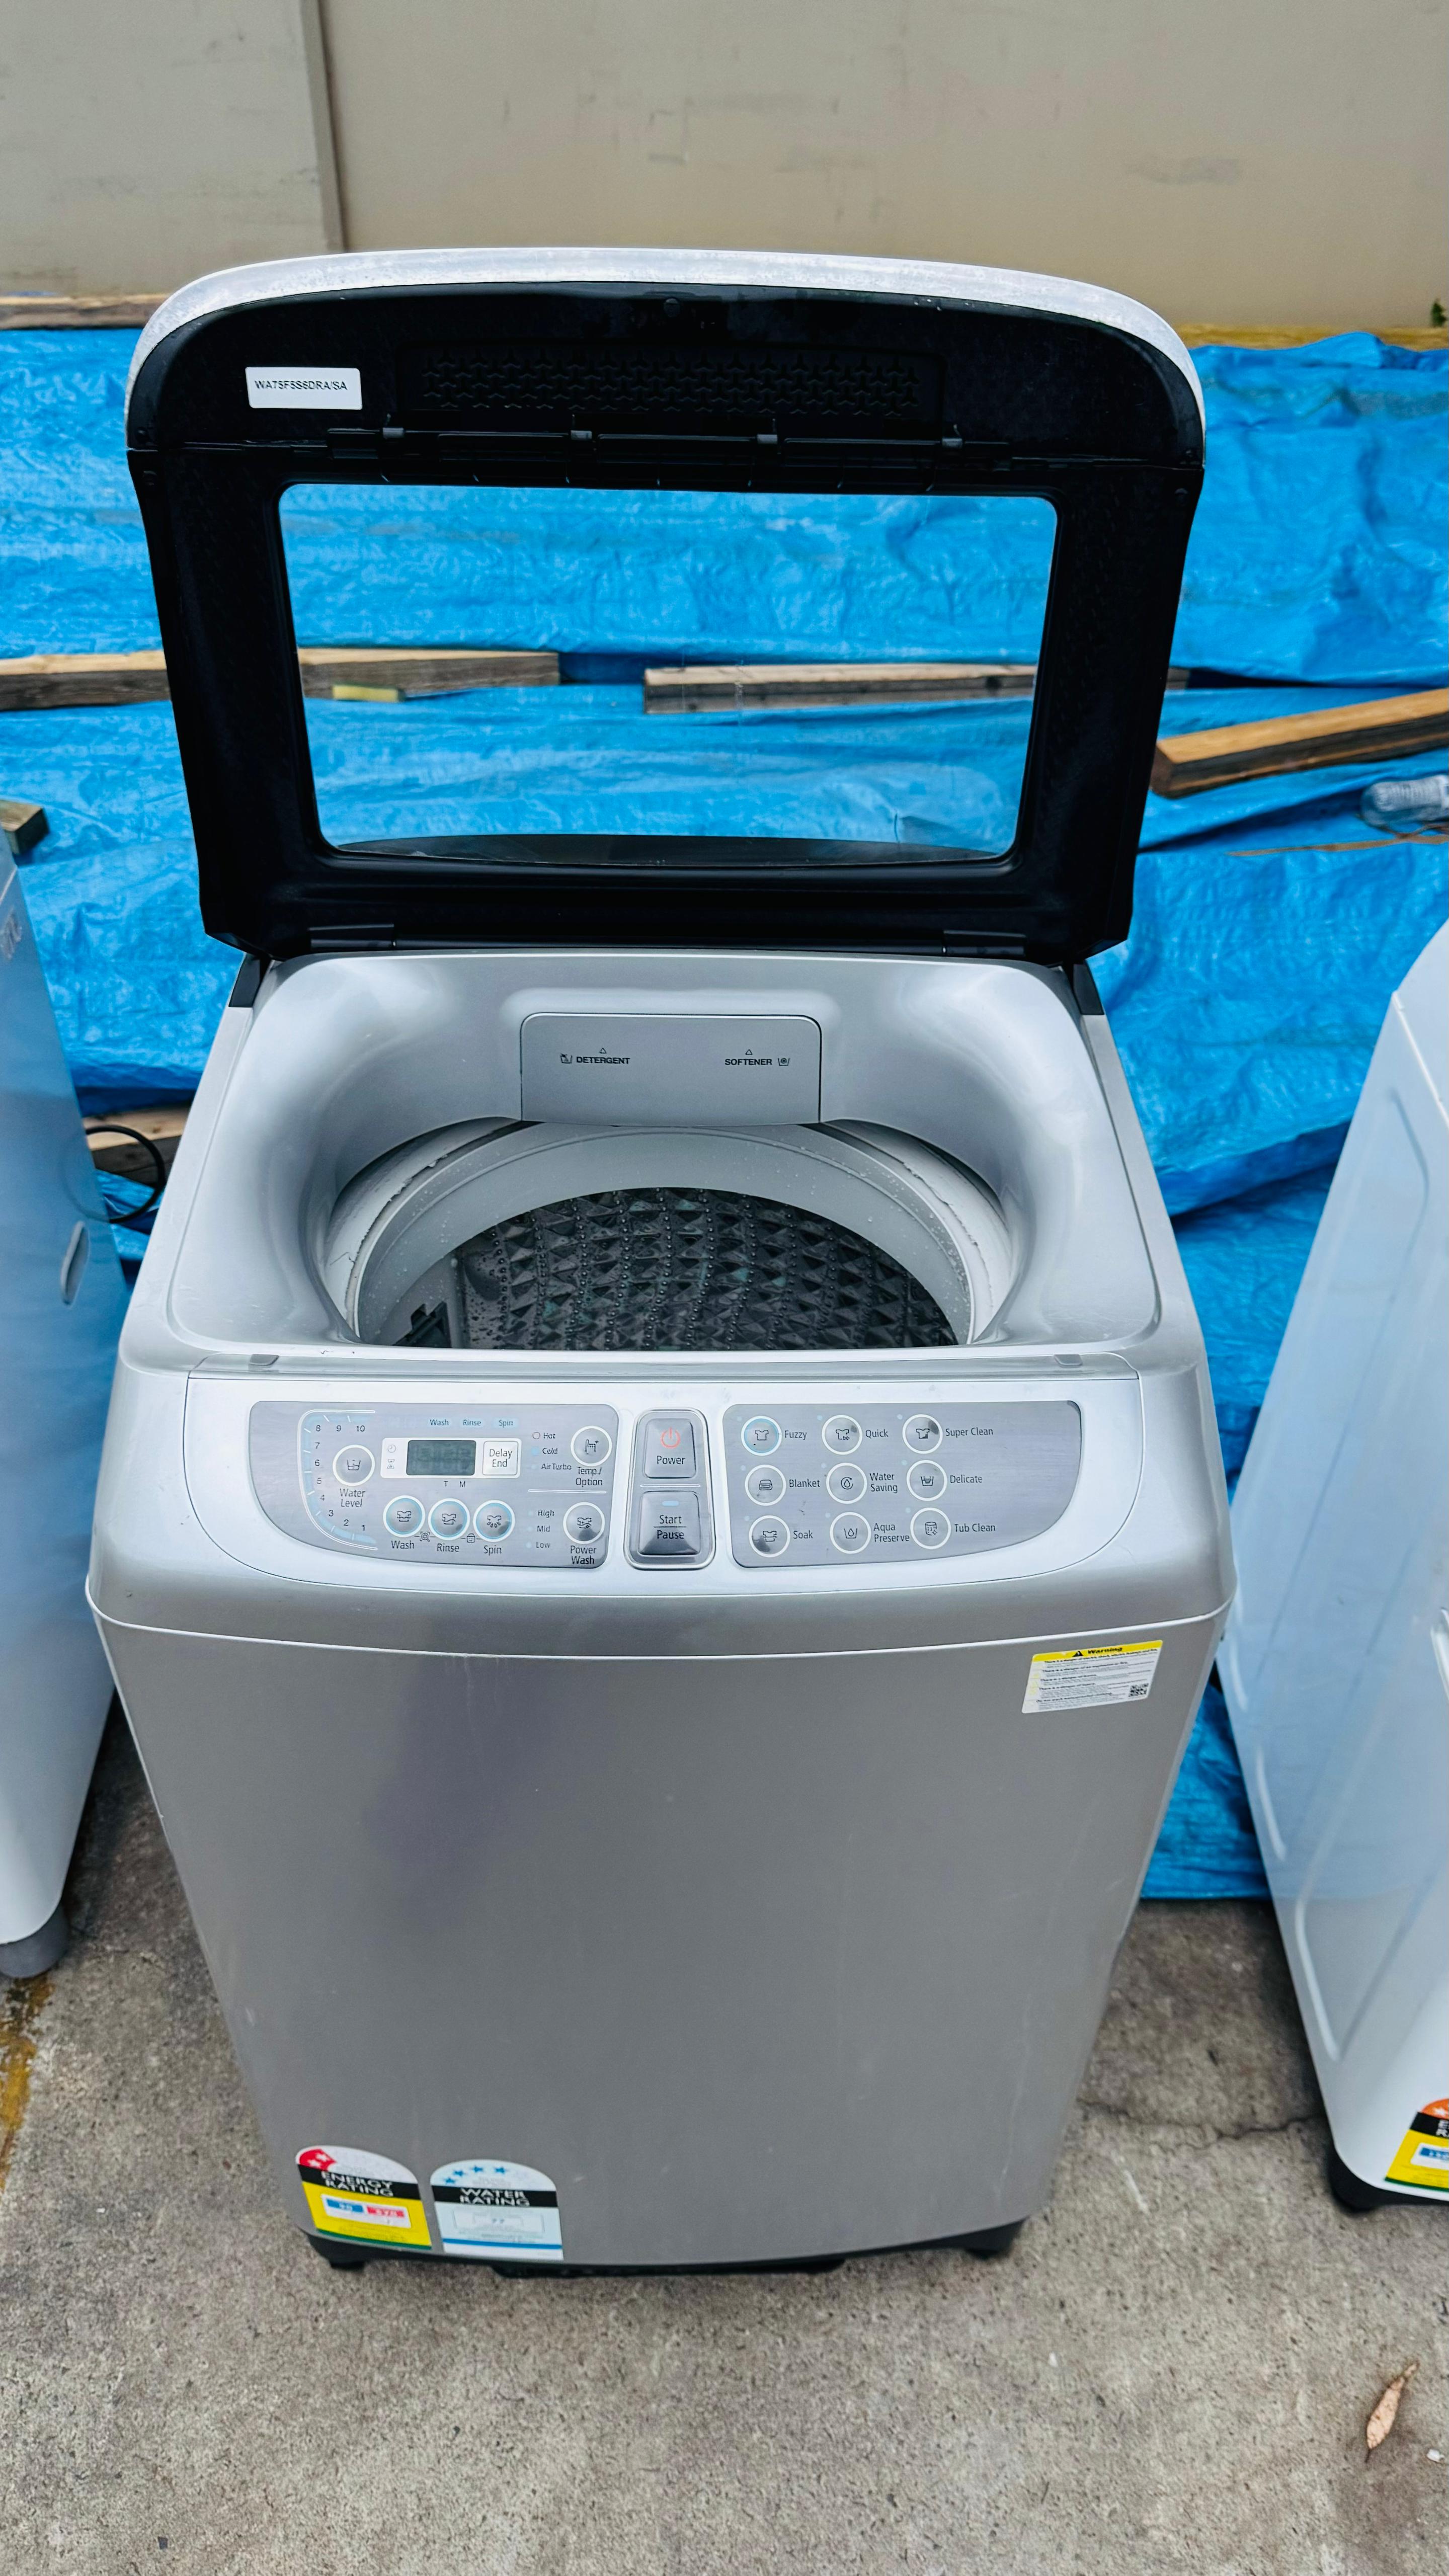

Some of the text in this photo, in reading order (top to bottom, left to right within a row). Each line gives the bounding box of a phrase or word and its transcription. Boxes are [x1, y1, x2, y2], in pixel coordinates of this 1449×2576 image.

[576, 1056, 630, 1065] DETERGENT
[784, 1430, 808, 1440] Fuzzy
[865, 1428, 889, 1439] Quick
[945, 1427, 994, 1438] Super Clean
[489, 1448, 513, 1459] Delay
[492, 1459, 508, 1468] End
[656, 1455, 685, 1465] Power
[869, 1472, 895, 1482] Water
[950, 1475, 983, 1484] Delicate
[576, 1478, 603, 1488] Option
[789, 1479, 821, 1488] Blanket
[340, 1488, 366, 1497] Water
[870, 1483, 898, 1494] Saving
[341, 1499, 363, 1507] Level
[537, 1510, 554, 1518] High
[659, 1514, 682, 1524] Start
[873, 1522, 896, 1533] Aqua
[954, 1522, 996, 1533] Tub Clean
[656, 1530, 685, 1540] Pause
[793, 1530, 814, 1540] Soak
[874, 1533, 910, 1543] Preserve
[391, 1540, 415, 1550] Wash
[437, 1543, 460, 1552] Rinse
[570, 1545, 597, 1554] Power
[483, 1545, 502, 1556] Spin
[571, 1555, 595, 1565] Wash
[1087, 1647, 1123, 1655] Warning
[321, 2170, 393, 2188] ENERGY
[325, 2179, 394, 2197] RATING
[460, 2187, 527, 2199] WATER
[459, 2195, 530, 2207] RATING
